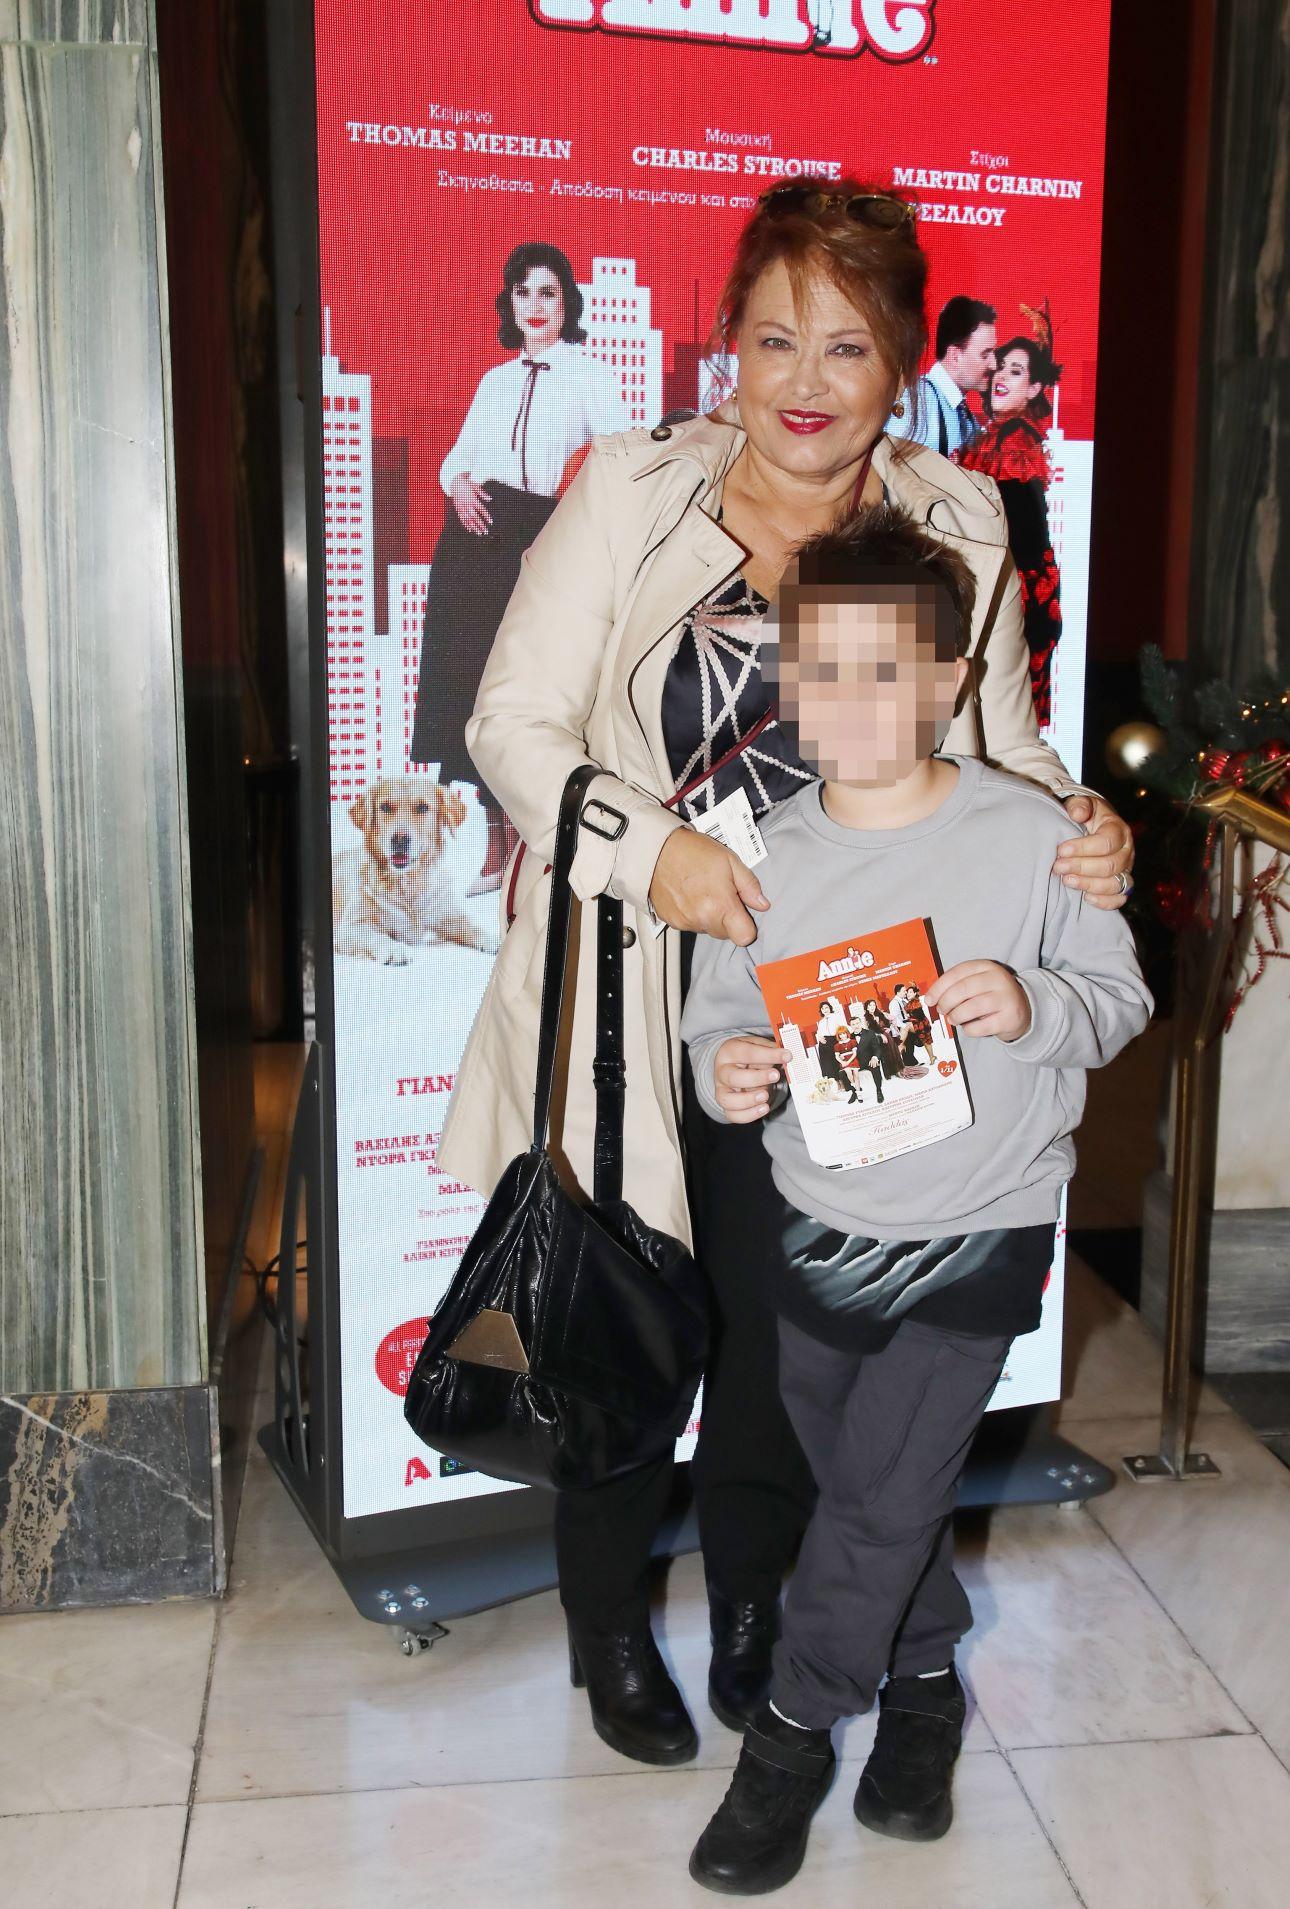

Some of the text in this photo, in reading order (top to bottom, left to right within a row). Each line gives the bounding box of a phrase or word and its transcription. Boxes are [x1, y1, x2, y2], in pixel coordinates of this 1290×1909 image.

[346, 121, 572, 160] THOMAS MEEHAN
[705, 128, 772, 151] Μουσική
[632, 146, 841, 181] CHARLES STROUSE
[893, 167, 1083, 199] MARTIN CHARNIN
[701, 193, 726, 207] και
[817, 947, 875, 982] Annie
[396, 1073, 456, 1097] ΓΙΑΝ
